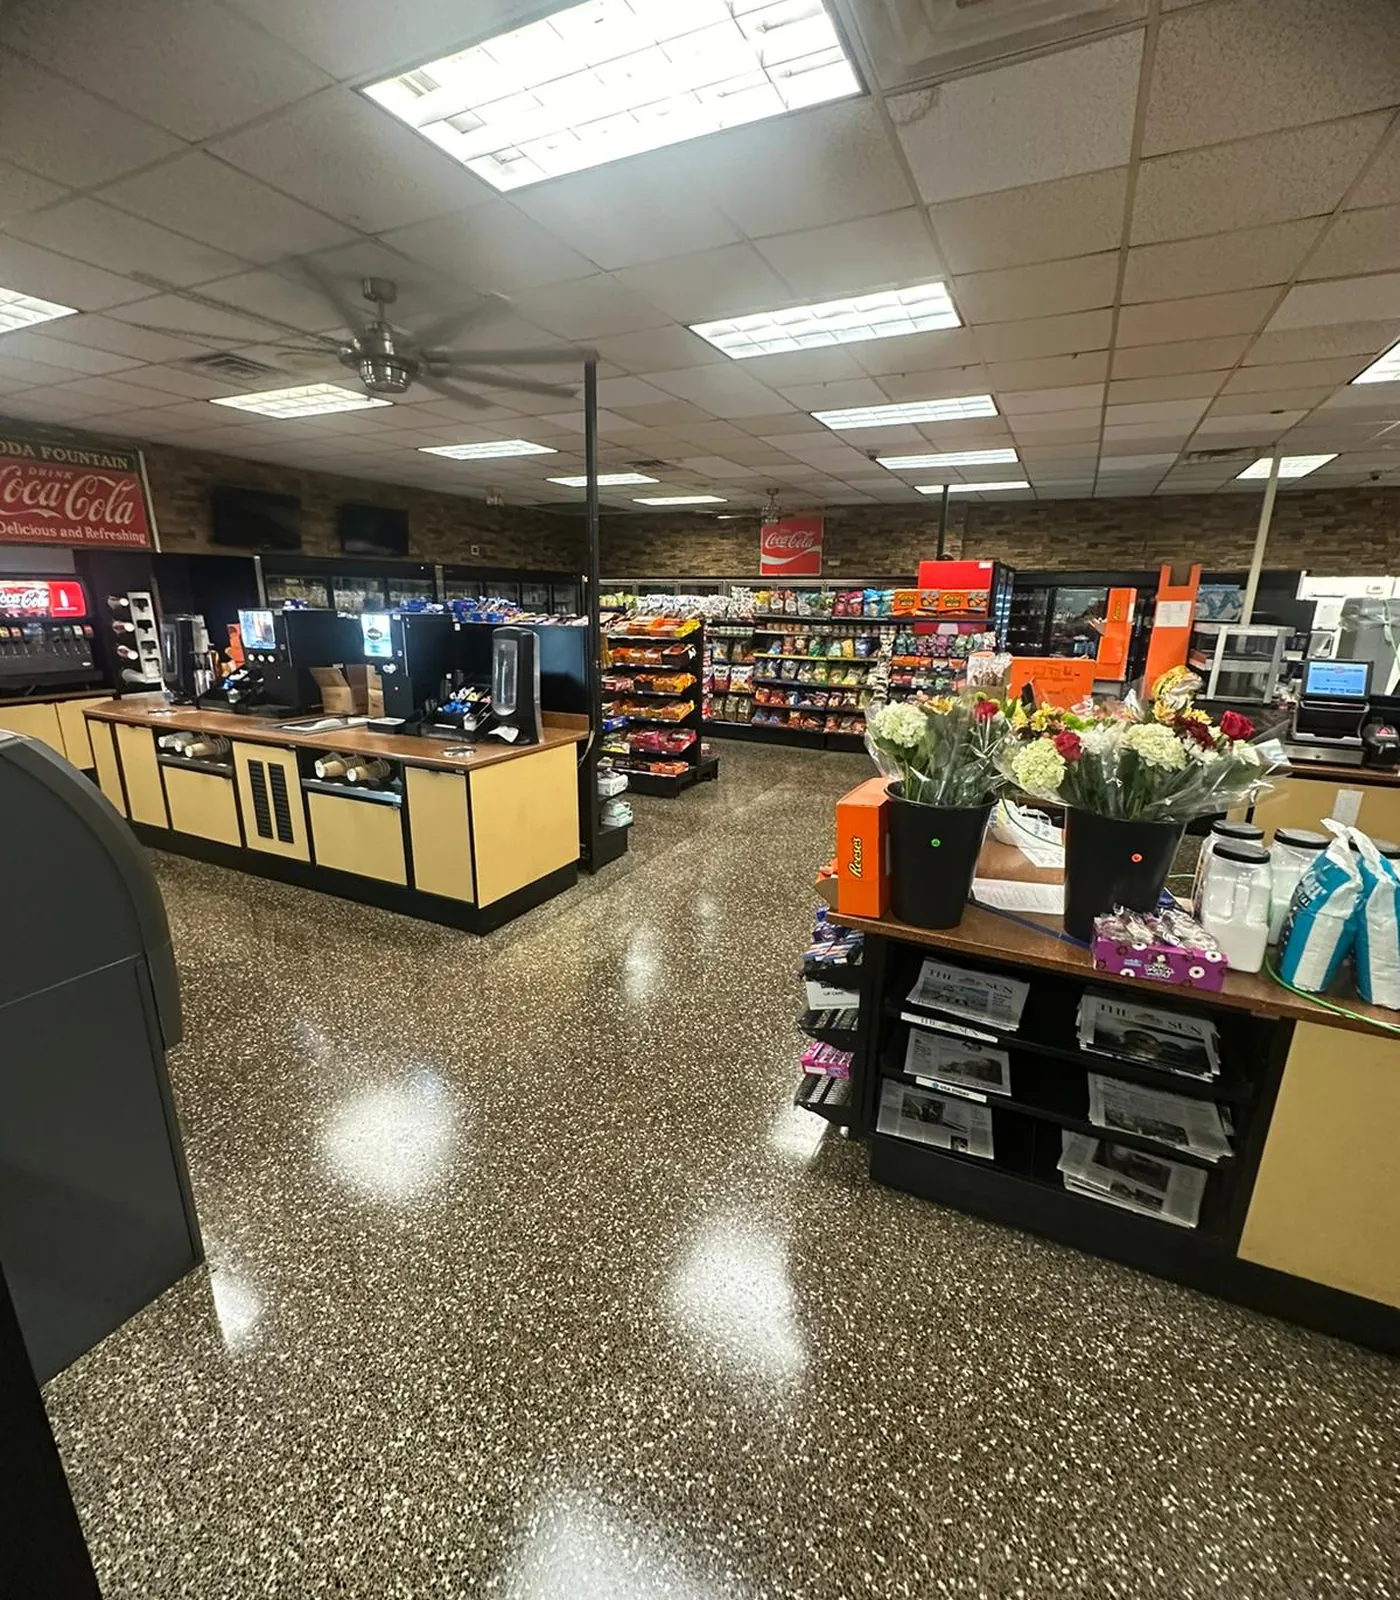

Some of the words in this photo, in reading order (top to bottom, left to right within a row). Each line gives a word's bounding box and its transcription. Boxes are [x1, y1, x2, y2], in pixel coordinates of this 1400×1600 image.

[41, 446, 128, 469] FOUNTAIN
[29, 466, 74, 479] DRINK
[0, 521, 57, 537] Delicious
[60, 524, 83, 539] and
[85, 526, 146, 545] Refreshing
[765, 531, 815, 549] Coca-Cola
[928, 967, 951, 980] THE
[985, 982, 1013, 994] SUN
[1100, 1003, 1126, 1016] THE
[1168, 1021, 1203, 1037] SUN
